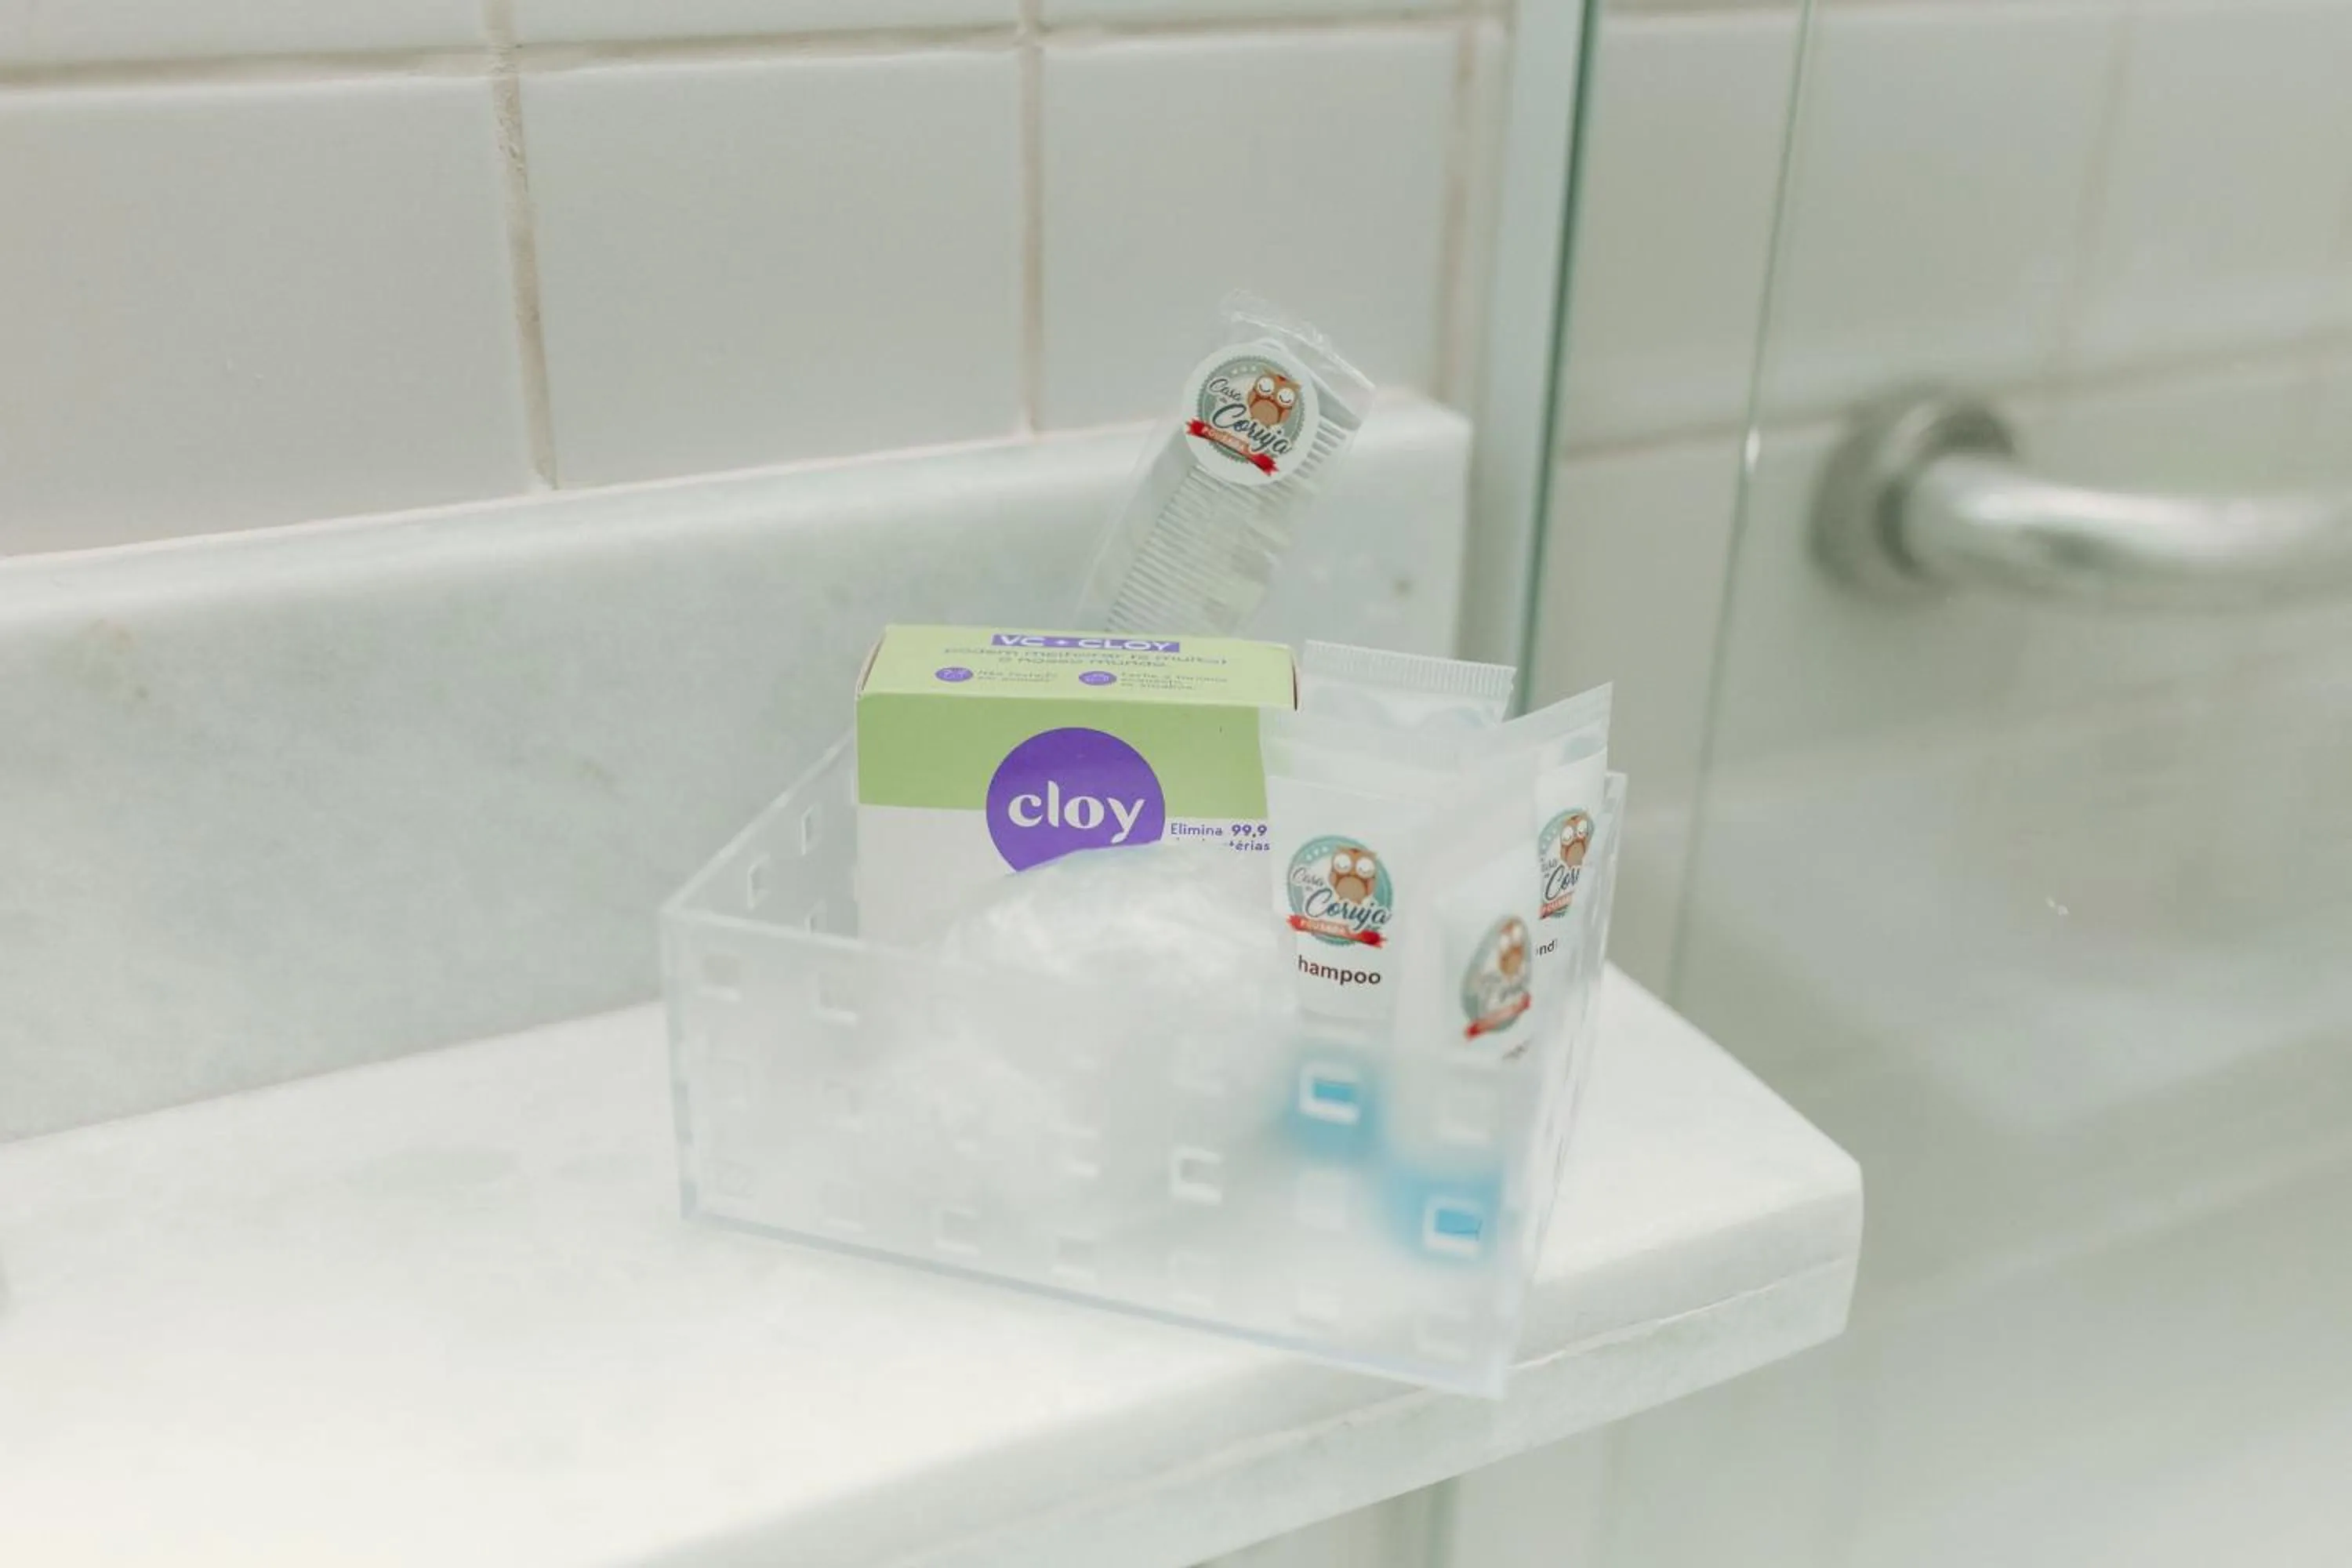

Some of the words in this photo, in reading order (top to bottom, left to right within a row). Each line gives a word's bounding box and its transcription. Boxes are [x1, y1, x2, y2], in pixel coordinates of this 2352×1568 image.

[1212, 403, 1292, 455] Coruja
[1000, 635, 1045, 646] VC
[1078, 639, 1171, 653] CLOY
[1008, 780, 1145, 844] cloy
[1171, 823, 1223, 837] Elimina
[1305, 888, 1392, 931] Coruja
[1298, 954, 1381, 985] hampoo
